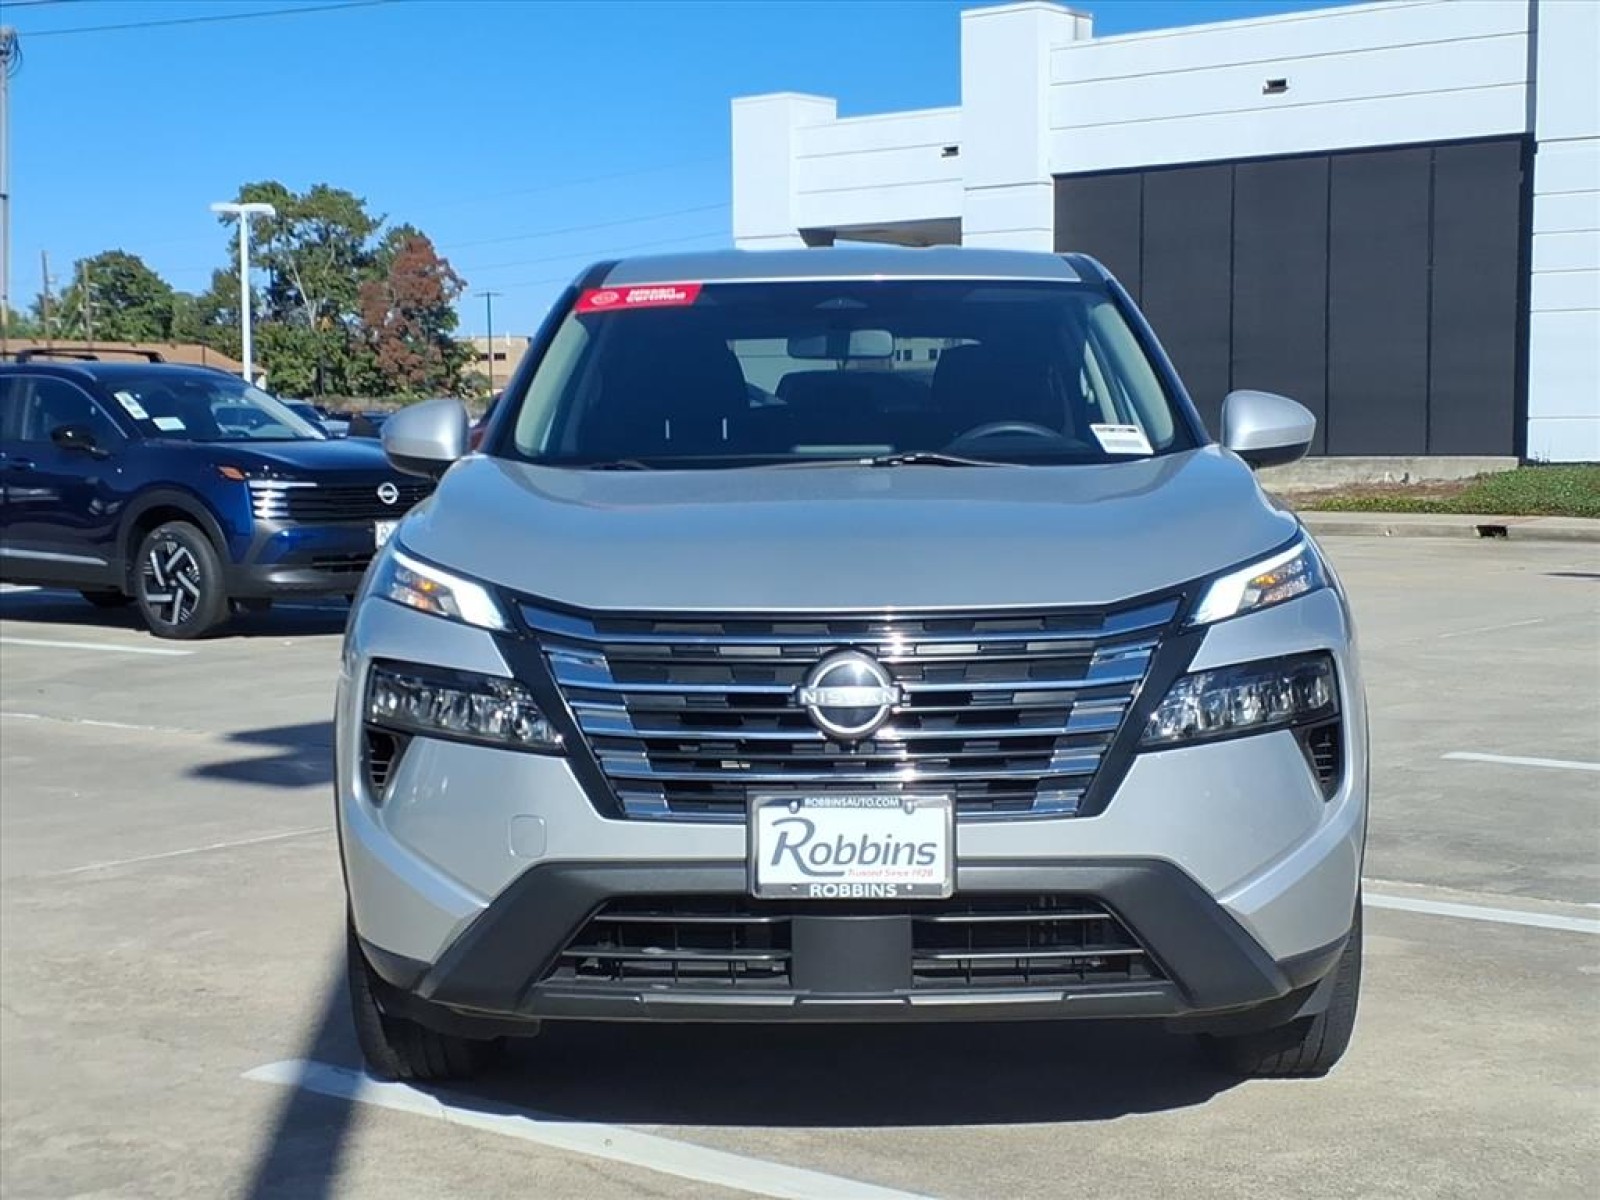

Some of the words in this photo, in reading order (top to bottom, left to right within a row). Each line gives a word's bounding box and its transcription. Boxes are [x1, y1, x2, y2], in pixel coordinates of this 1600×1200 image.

[804, 797, 899, 807] ROBBINSAUTO.COM
[771, 817, 938, 877] Robbins
[810, 884, 897, 897] ROBBINS
